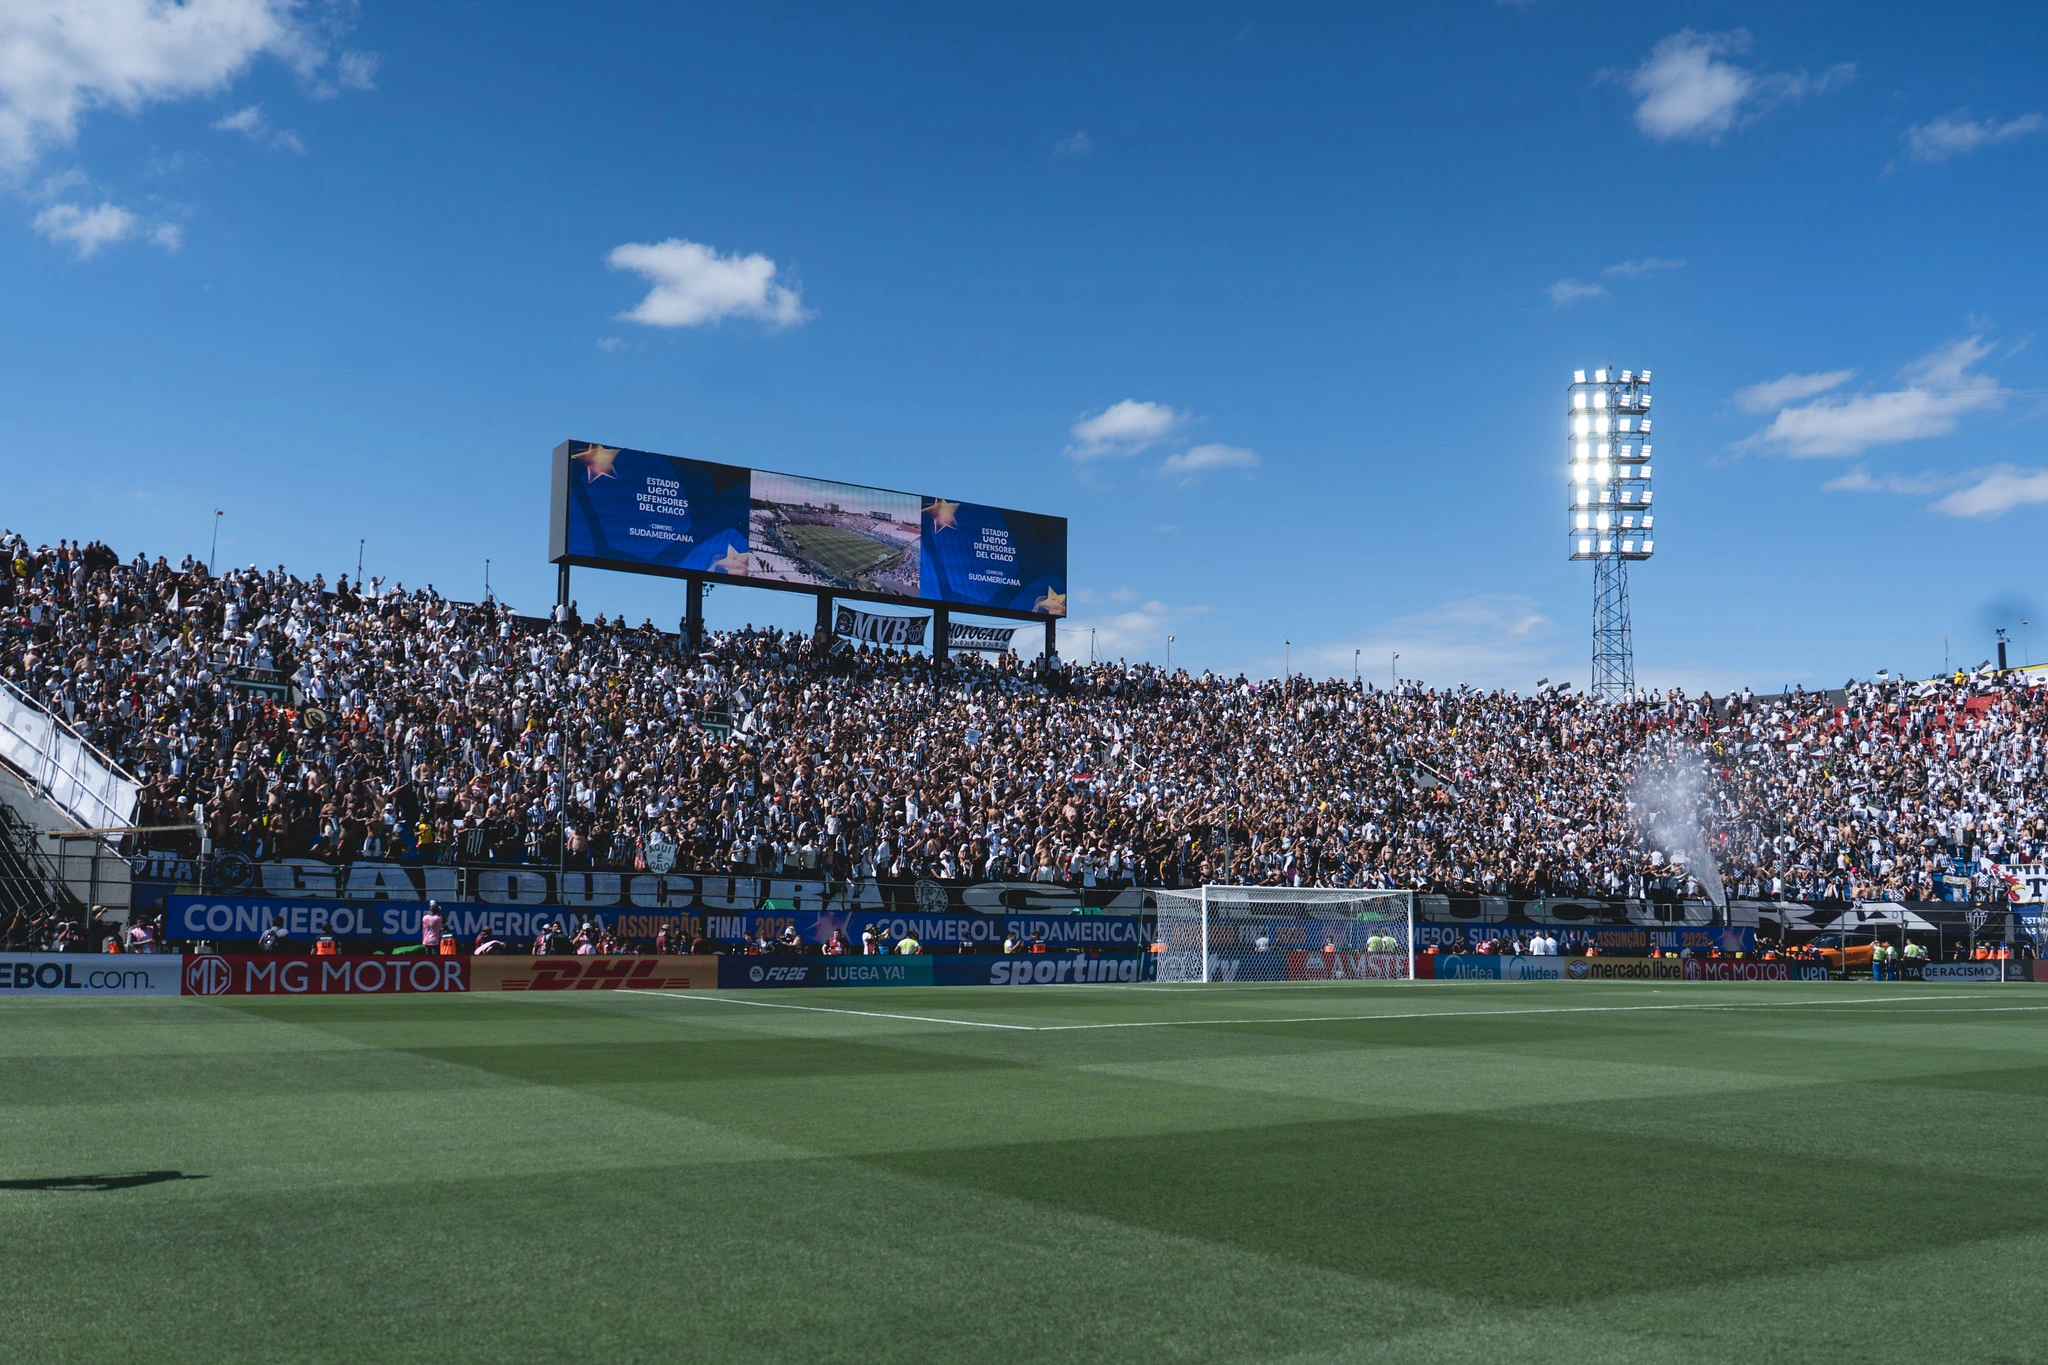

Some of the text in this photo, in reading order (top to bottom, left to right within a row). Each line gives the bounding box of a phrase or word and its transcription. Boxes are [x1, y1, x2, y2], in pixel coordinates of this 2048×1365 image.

[646, 477, 680, 489] ESTADIO
[647, 486, 678, 497] ueno
[636, 493, 689, 508] DEFENSORES
[639, 502, 685, 516] DEL CHACO
[629, 527, 694, 543] SUDAMERICANA
[981, 527, 1009, 538] ESTADIO
[982, 535, 1007, 545] ueno
[973, 541, 1017, 555] DEFENSORES
[975, 550, 1014, 562] DEL CHACO
[968, 573, 1021, 586] SUDAMERICANA
[851, 612, 911, 644] MVB
[649, 844, 672, 853] AQUI
[650, 862, 670, 871] GALO
[183, 903, 372, 935] CONMEBOL
[245, 961, 309, 993] MG
[321, 960, 466, 992] MOTOR
[528, 959, 667, 991] DHL
[826, 966, 905, 980] ¡JUEGA YA!
[1452, 962, 1494, 980] Midea
[1518, 962, 1558, 980] Midea
[1591, 961, 1681, 979] mercado libre
[1705, 963, 1730, 981] MG
[1733, 963, 1787, 981] MOTOR
[1925, 968, 1938, 976] DE
[1940, 967, 1995, 977] RACISMO
